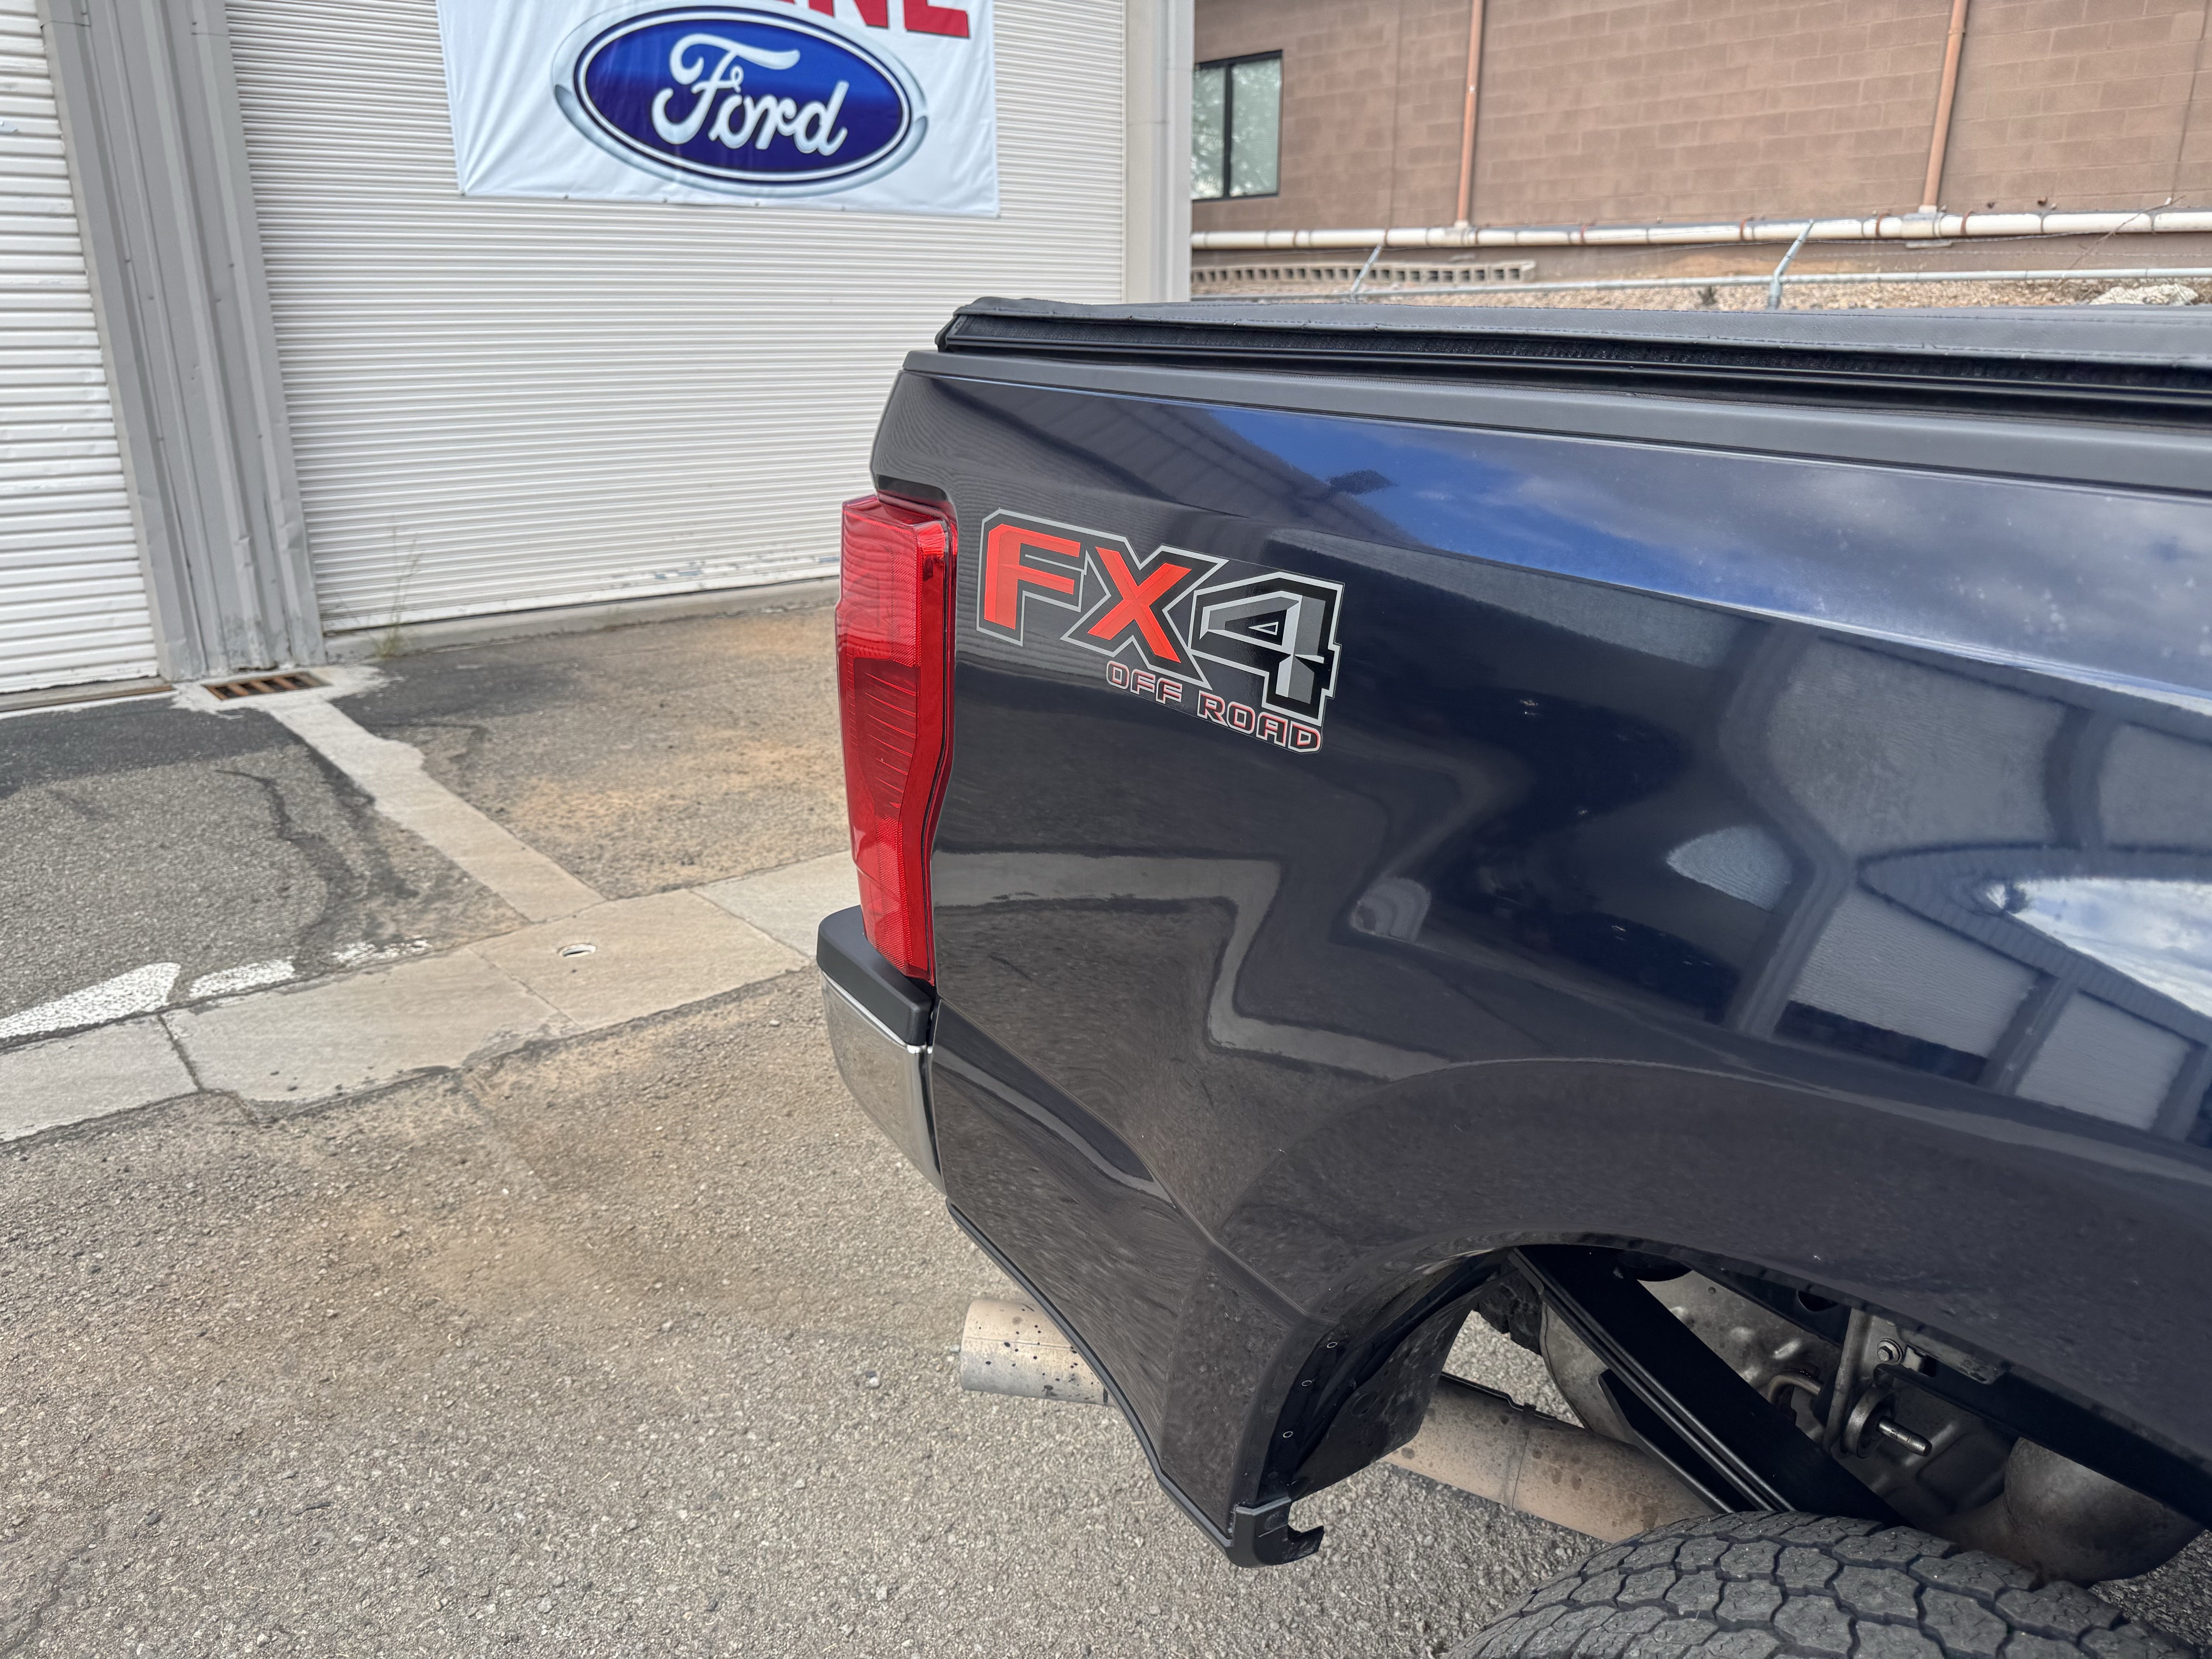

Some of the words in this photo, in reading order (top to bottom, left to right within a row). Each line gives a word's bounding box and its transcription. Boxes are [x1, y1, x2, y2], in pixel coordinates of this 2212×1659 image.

[651, 34, 848, 156] Ford
[977, 508, 1345, 726] FX4
[1106, 661, 1183, 702] OFF
[1197, 690, 1321, 752] ROAD
